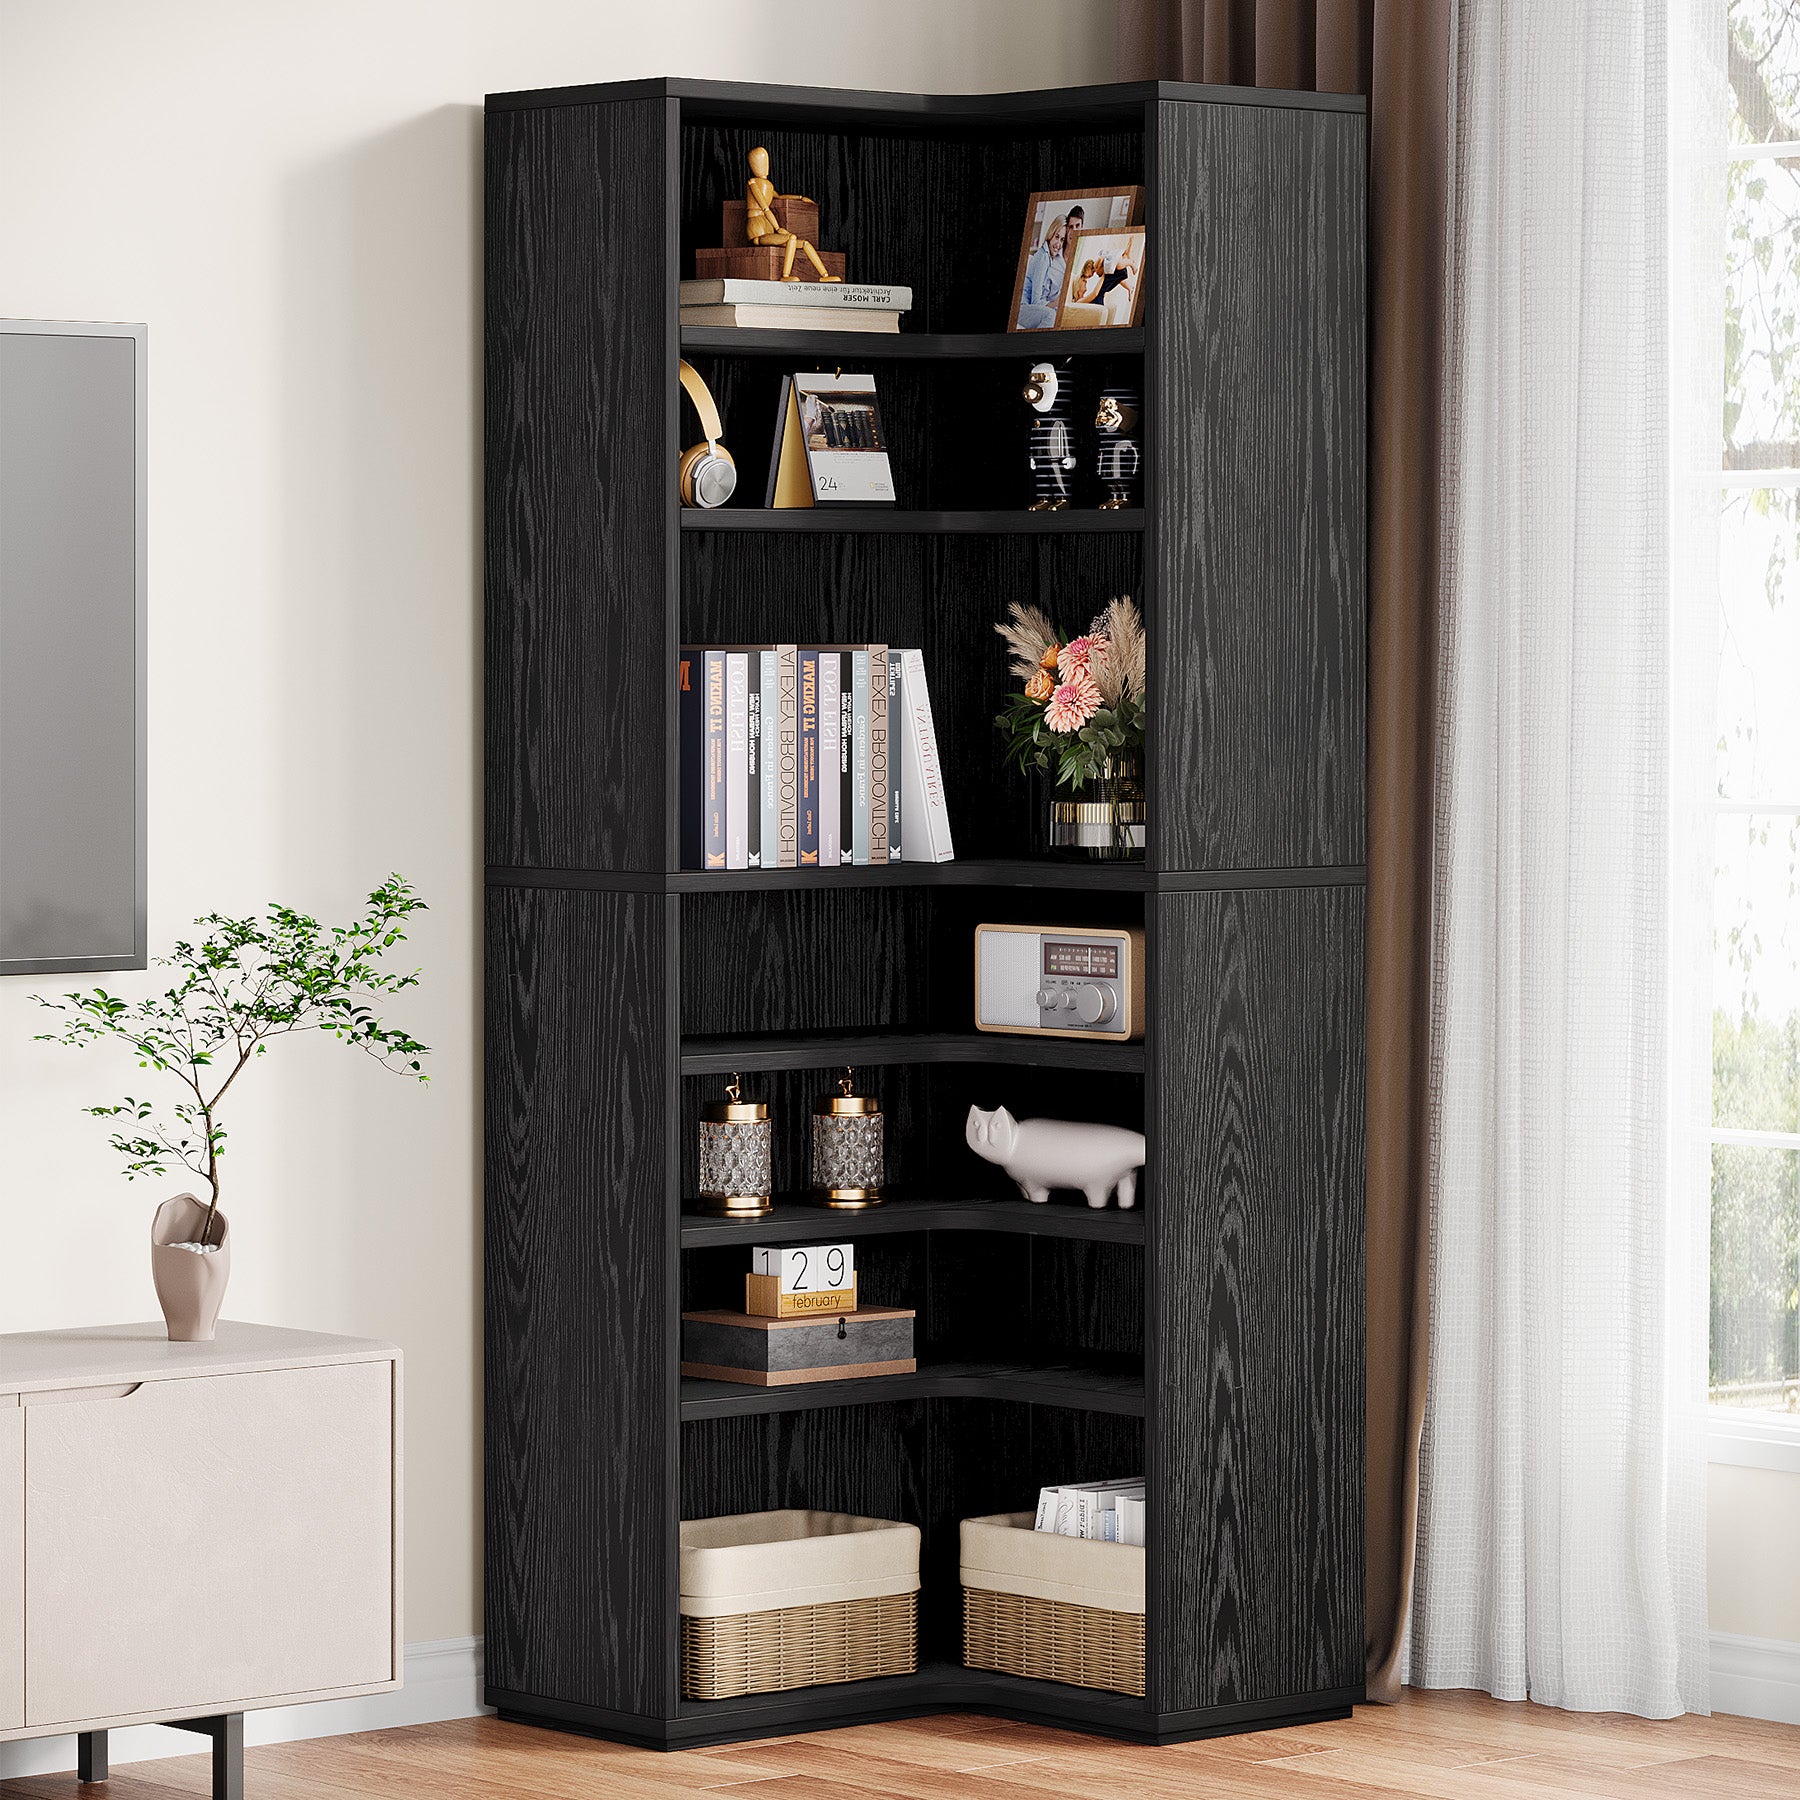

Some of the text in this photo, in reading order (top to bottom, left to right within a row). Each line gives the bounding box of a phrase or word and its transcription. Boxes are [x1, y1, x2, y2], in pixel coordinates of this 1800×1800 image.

[788, 284, 802, 292] Zeit
[852, 288, 892, 296] Architektur
[872, 296, 890, 304] CARL
[818, 476, 838, 491] 24
[761, 1250, 769, 1276] 1
[793, 1294, 841, 1309] february
